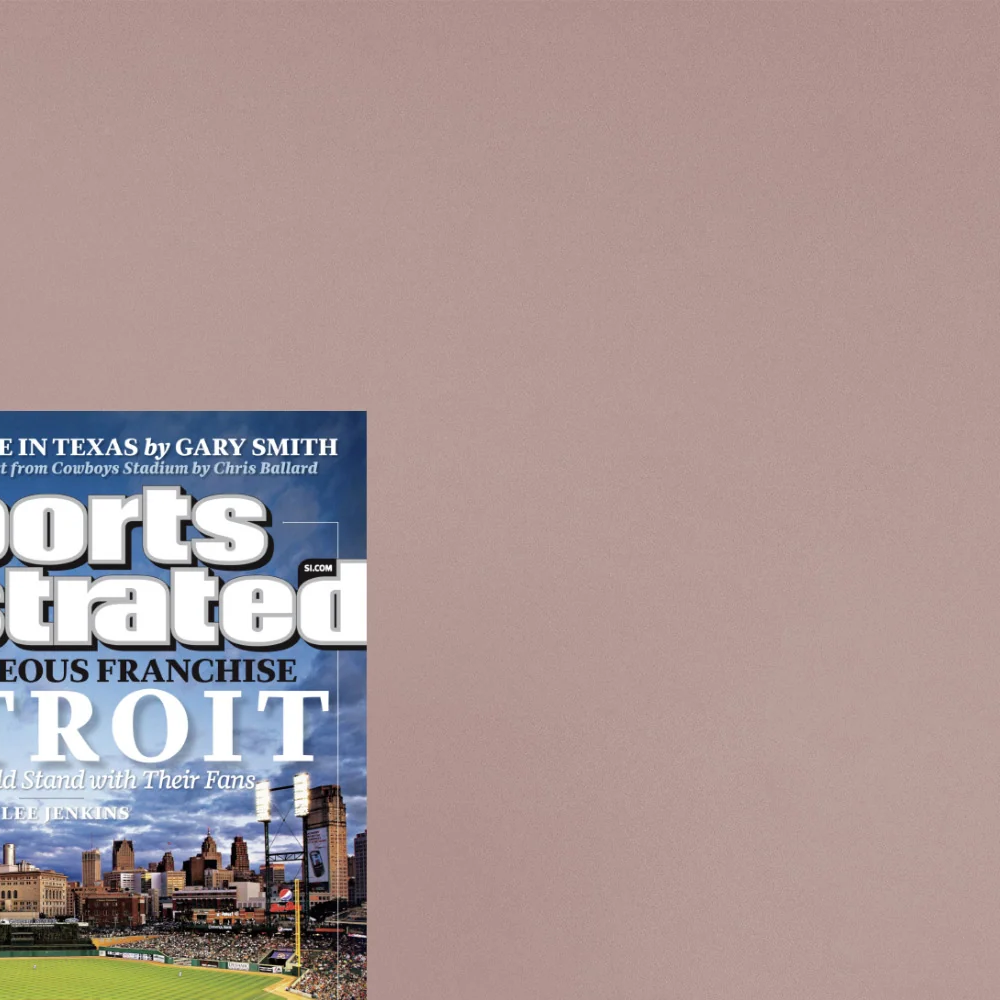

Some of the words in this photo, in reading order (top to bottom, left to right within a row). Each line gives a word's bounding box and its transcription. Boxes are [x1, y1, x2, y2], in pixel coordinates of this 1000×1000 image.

[18, 438, 48, 456] IN
[52, 438, 139, 456] TEXAS
[144, 437, 170, 459] by
[175, 438, 246, 456] GARY
[251, 438, 338, 456] SMITH
[10, 461, 48, 478] from
[52, 461, 120, 478] Cowboys
[123, 461, 188, 475] Stadium
[192, 461, 210, 478] by
[214, 461, 257, 475] Chris
[260, 461, 318, 475] Ballard
[304, 564, 333, 572] SI.COM
[97, 658, 297, 683] FRANCHISE
[21, 770, 84, 789] Stand
[89, 770, 137, 789] with
[143, 770, 200, 789] Their
[204, 770, 255, 789] Fans
[1, 807, 38, 820] LEE
[45, 806, 131, 823] JENKINS
